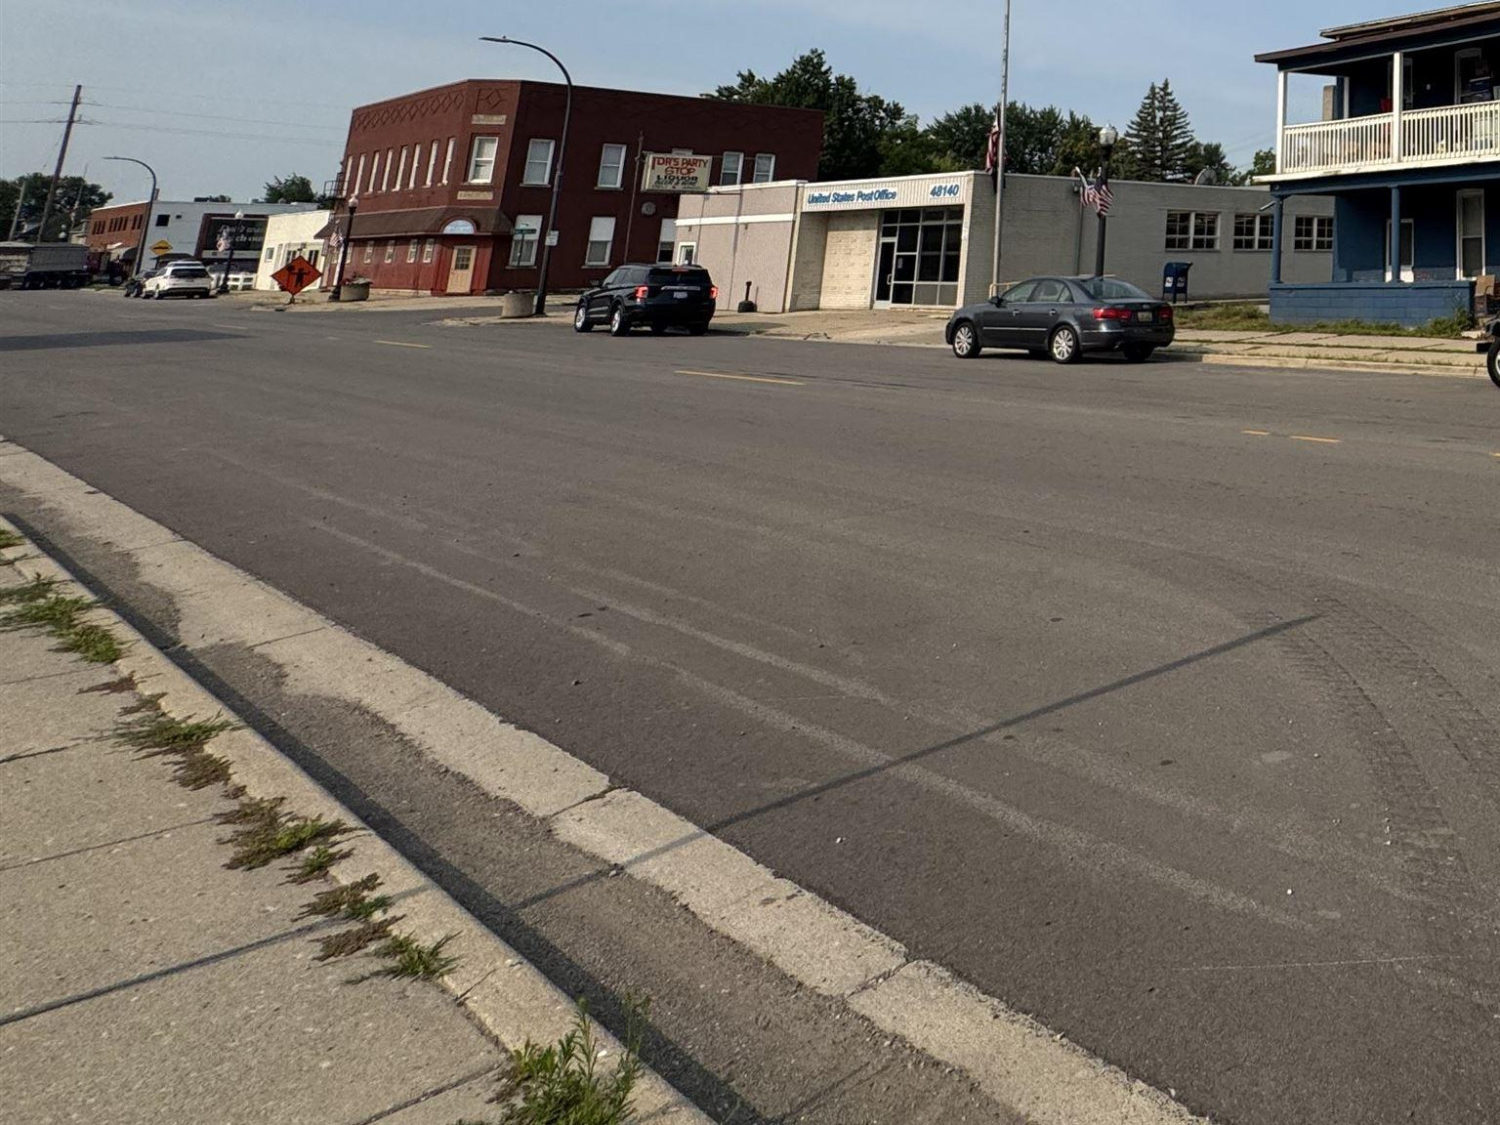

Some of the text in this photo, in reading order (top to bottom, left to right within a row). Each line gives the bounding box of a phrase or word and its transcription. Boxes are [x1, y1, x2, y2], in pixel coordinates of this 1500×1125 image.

[681, 158, 708, 168] PARTY
[665, 166, 696, 175] STOP
[808, 188, 897, 204] United States Post Office
[930, 184, 959, 197] 48140
